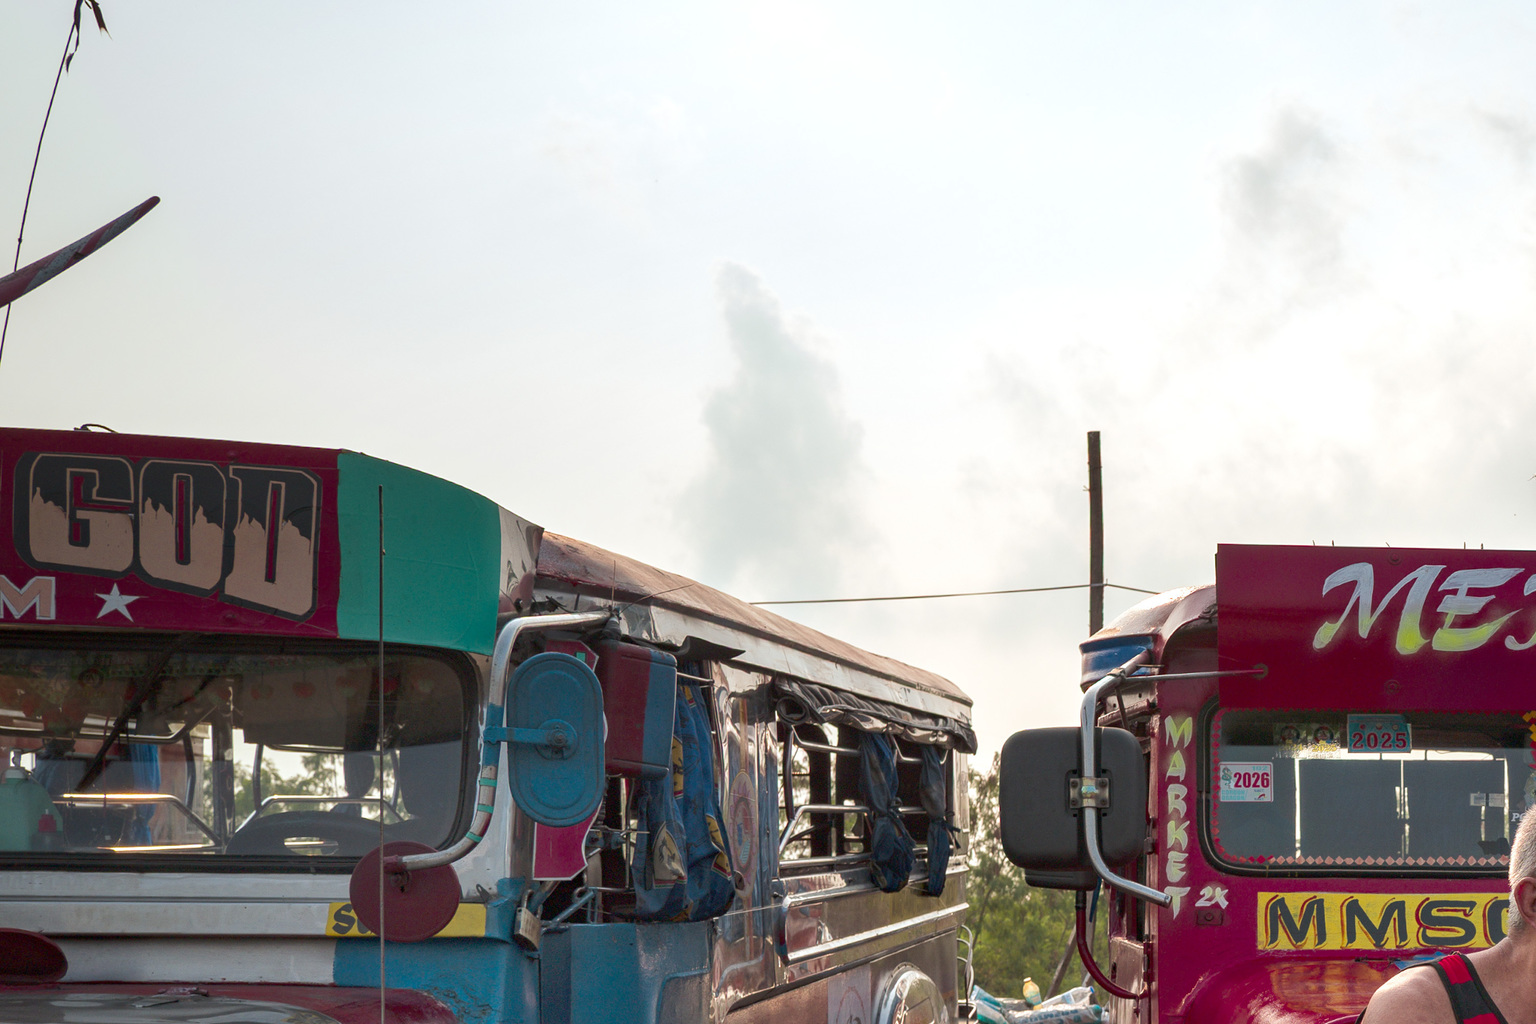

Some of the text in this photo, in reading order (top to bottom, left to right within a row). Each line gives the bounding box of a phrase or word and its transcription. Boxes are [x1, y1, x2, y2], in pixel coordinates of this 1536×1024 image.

[13, 452, 322, 622] GOD
[1233, 771, 1270, 789] 2026
[1351, 732, 1408, 750] 2025
[1164, 715, 1229, 920] MARKET 2X
